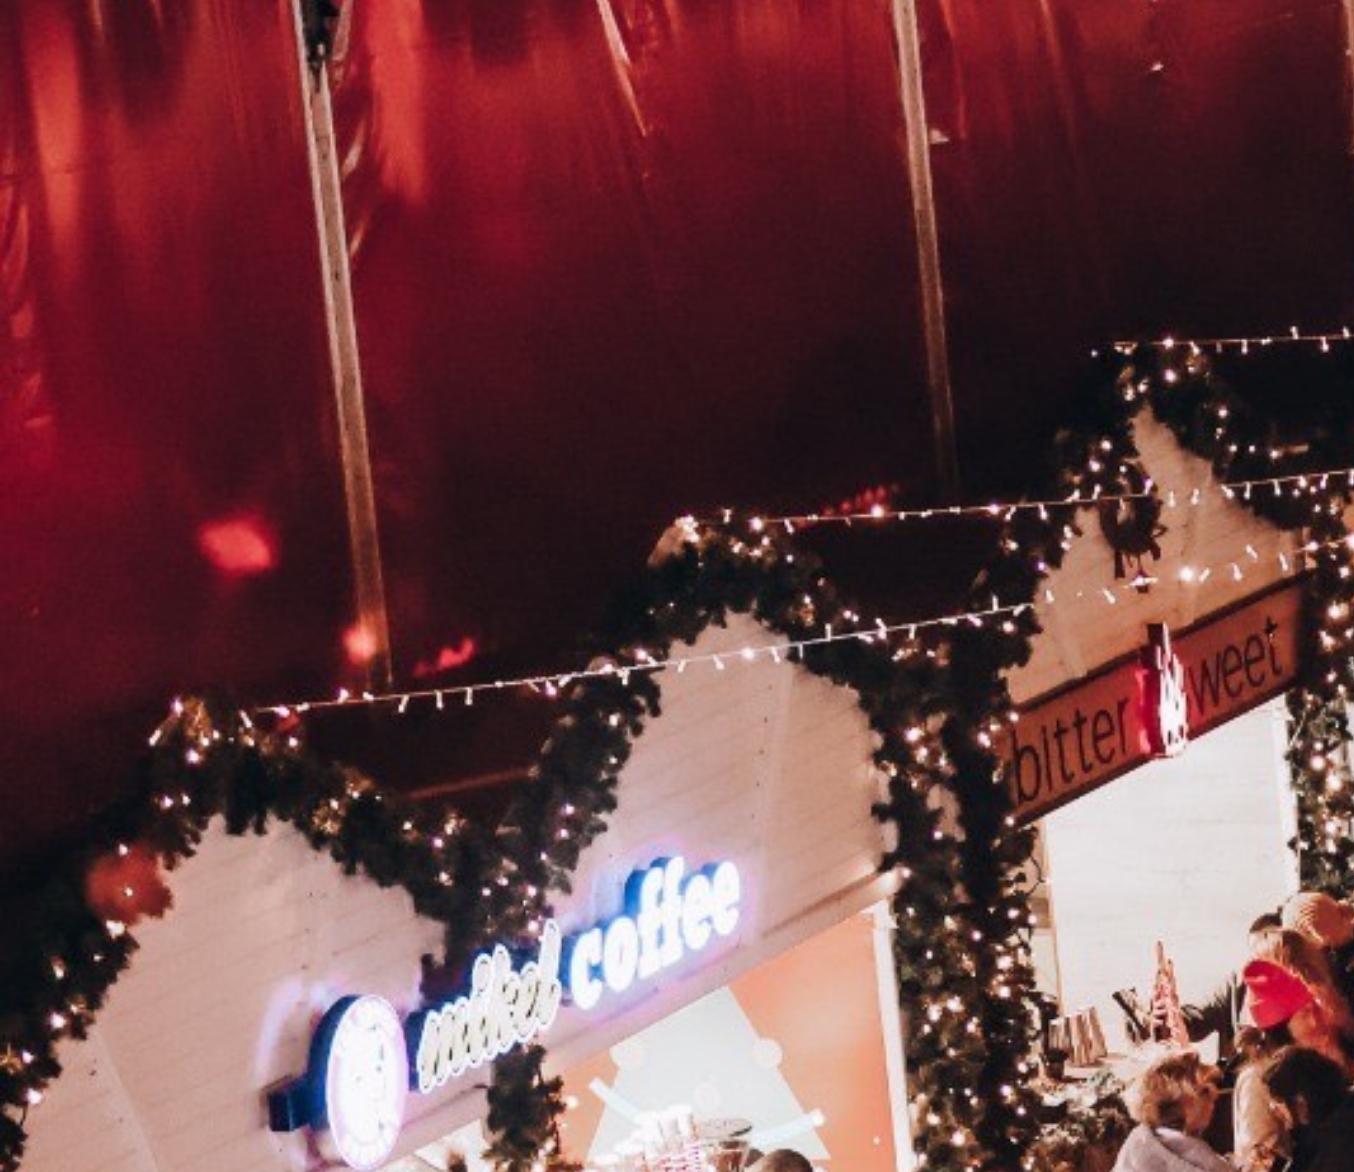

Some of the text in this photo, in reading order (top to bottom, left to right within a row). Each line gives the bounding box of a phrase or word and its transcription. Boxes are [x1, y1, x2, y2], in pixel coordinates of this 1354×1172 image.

[1011, 616, 1282, 803] bitter weet
[416, 856, 741, 1094] mikel coffee
